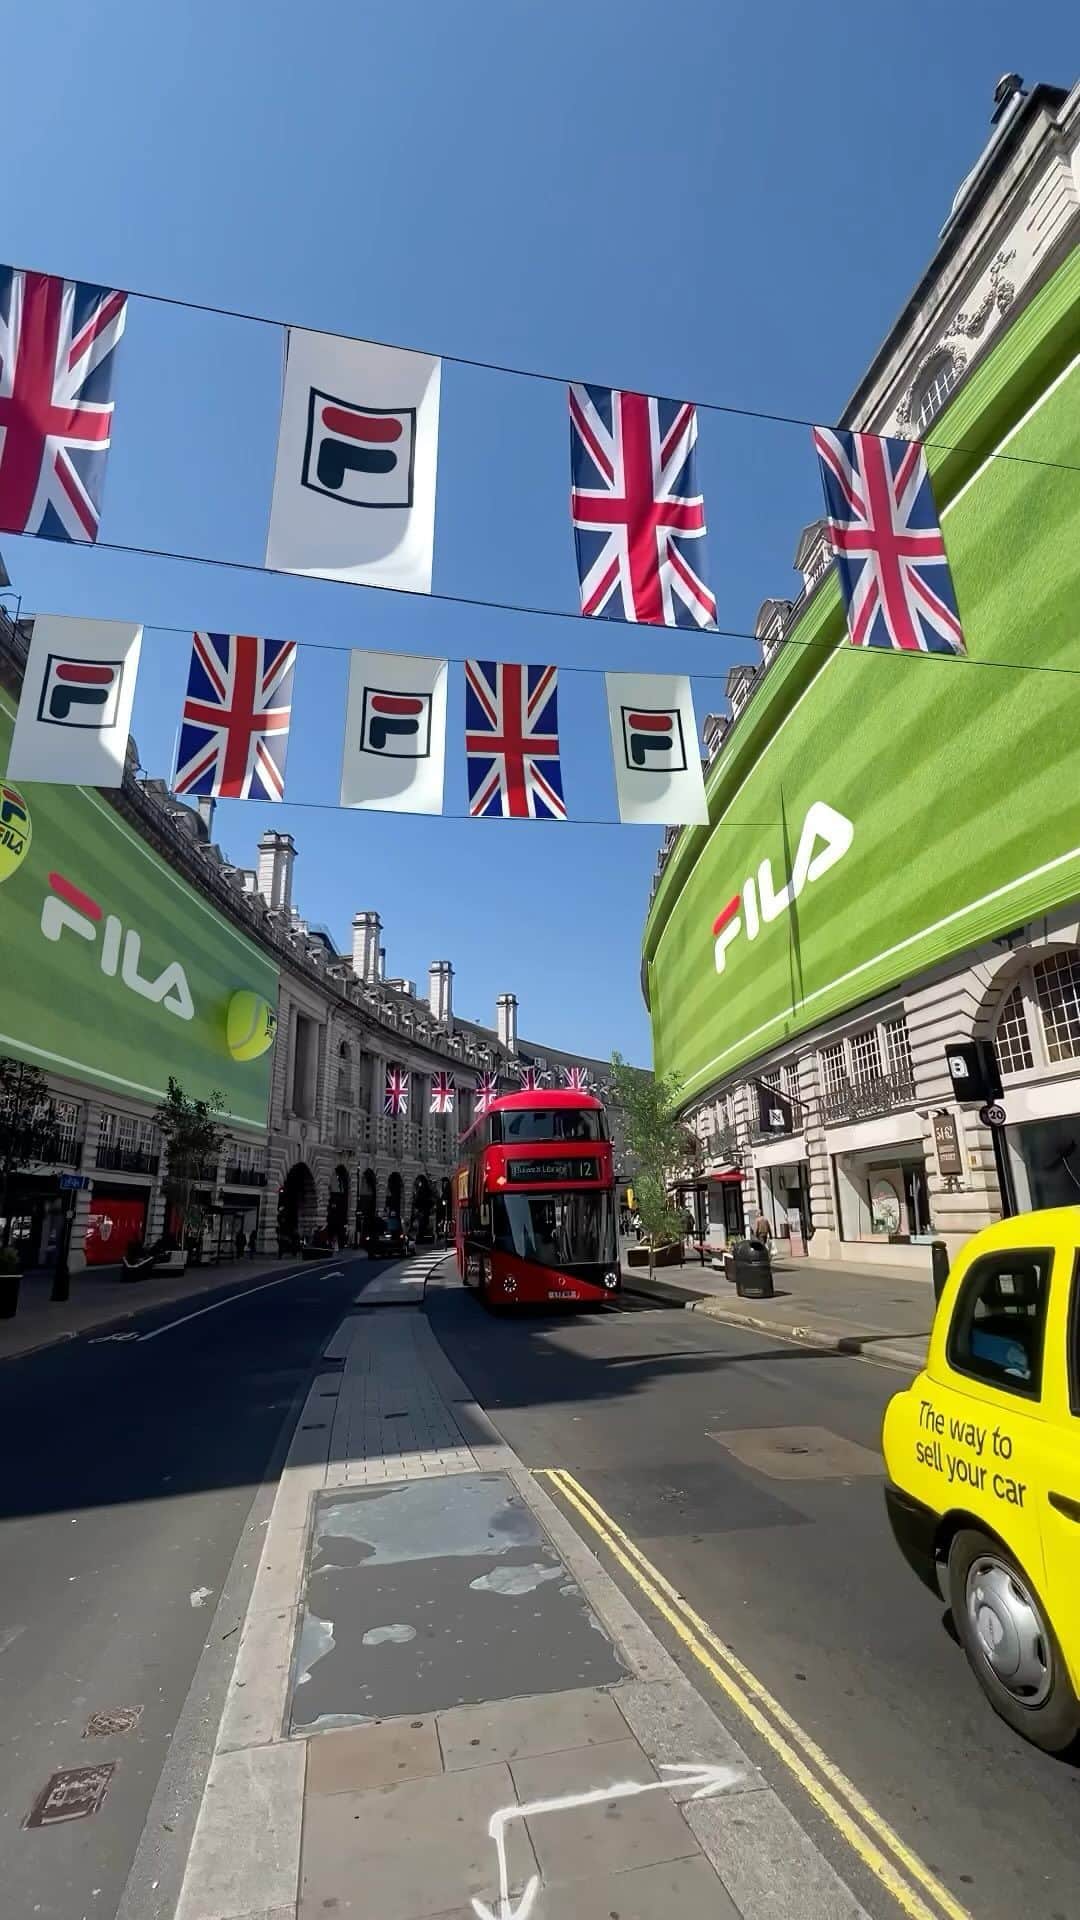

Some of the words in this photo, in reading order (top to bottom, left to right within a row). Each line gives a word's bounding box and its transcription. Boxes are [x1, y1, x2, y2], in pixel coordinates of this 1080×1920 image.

[711, 800, 854, 975] FILA
[40, 870, 195, 1021] FILA
[988, 1108, 1003, 1121] 20
[580, 1160, 592, 1177] 12
[919, 1400, 945, 1435] The
[950, 1418, 987, 1455] way
[992, 1426, 1013, 1460] to
[916, 1441, 944, 1472] sell
[946, 1454, 987, 1490] your
[993, 1473, 1027, 1507] car
